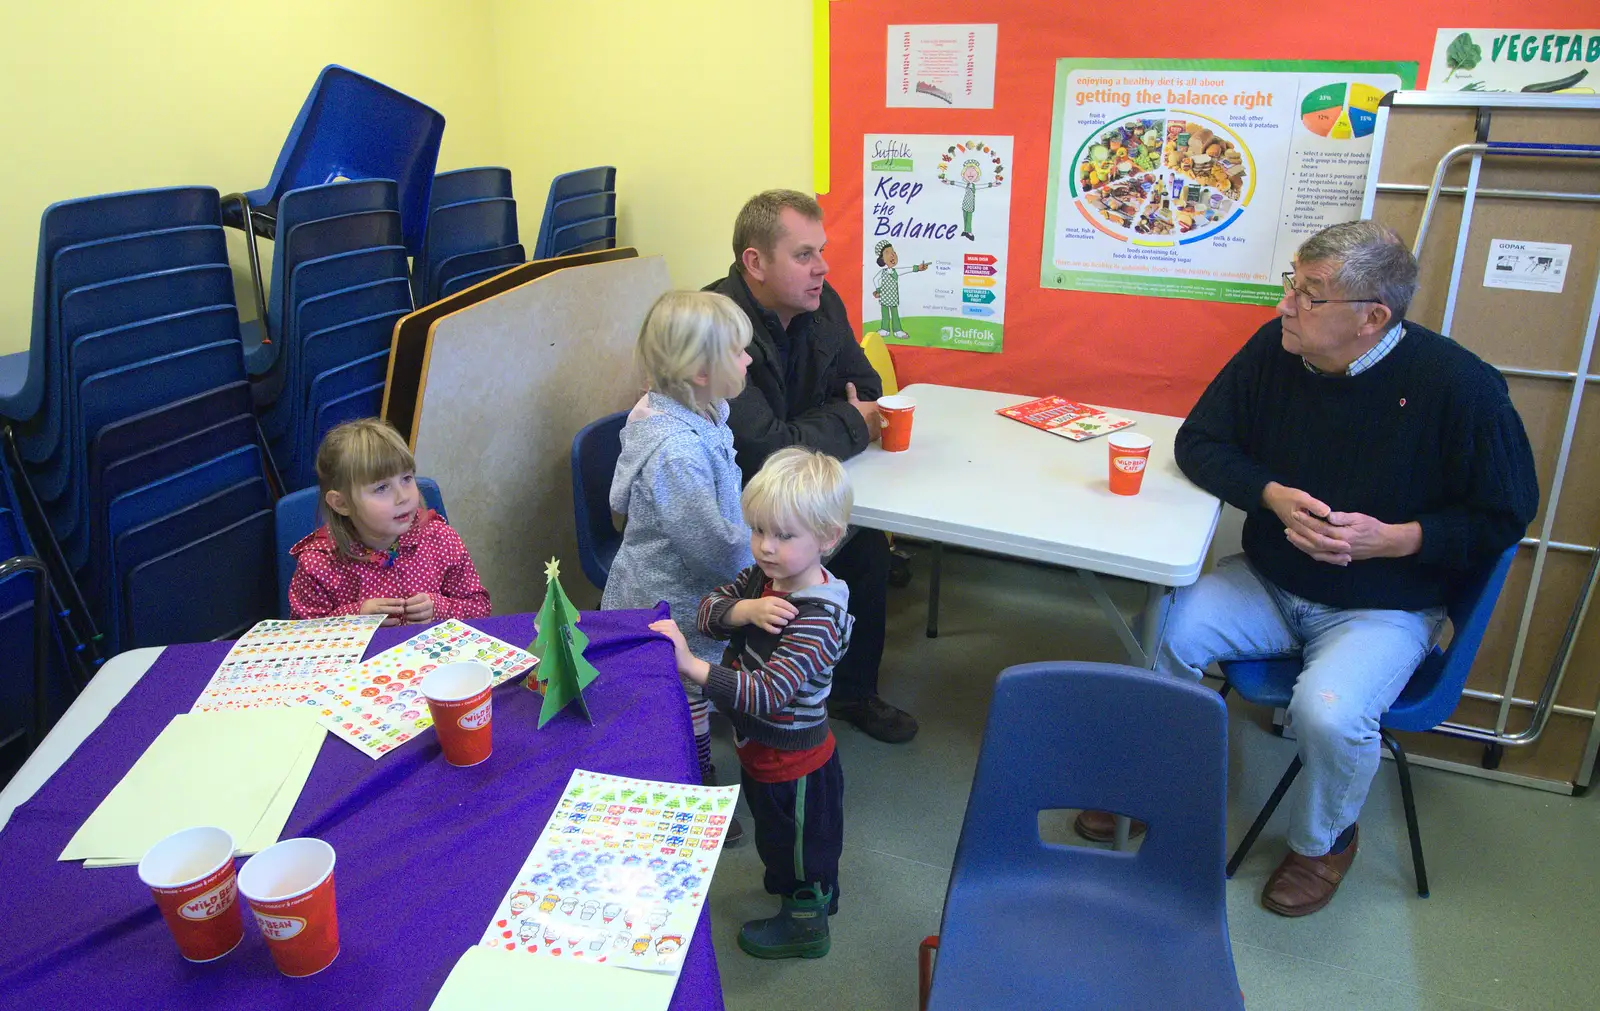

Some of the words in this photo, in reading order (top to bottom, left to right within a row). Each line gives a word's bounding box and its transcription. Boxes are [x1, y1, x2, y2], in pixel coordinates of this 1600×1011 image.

[1077, 77, 1113, 87] enjoying
[1123, 77, 1154, 87] healthy
[1157, 77, 1174, 86] diet
[1176, 78, 1183, 86] is
[1186, 78, 1197, 86] all
[1199, 78, 1225, 87] about
[1076, 88, 1131, 107] getting
[1136, 89, 1161, 103] the
[1167, 89, 1228, 105] balance
[1233, 90, 1273, 110] right
[871, 139, 912, 166] Suffolk
[873, 176, 924, 205] Keep
[872, 201, 896, 216] the
[873, 216, 959, 240] Balance
[954, 327, 994, 341] Suffolk
[264, 919, 292, 929] BEAN
